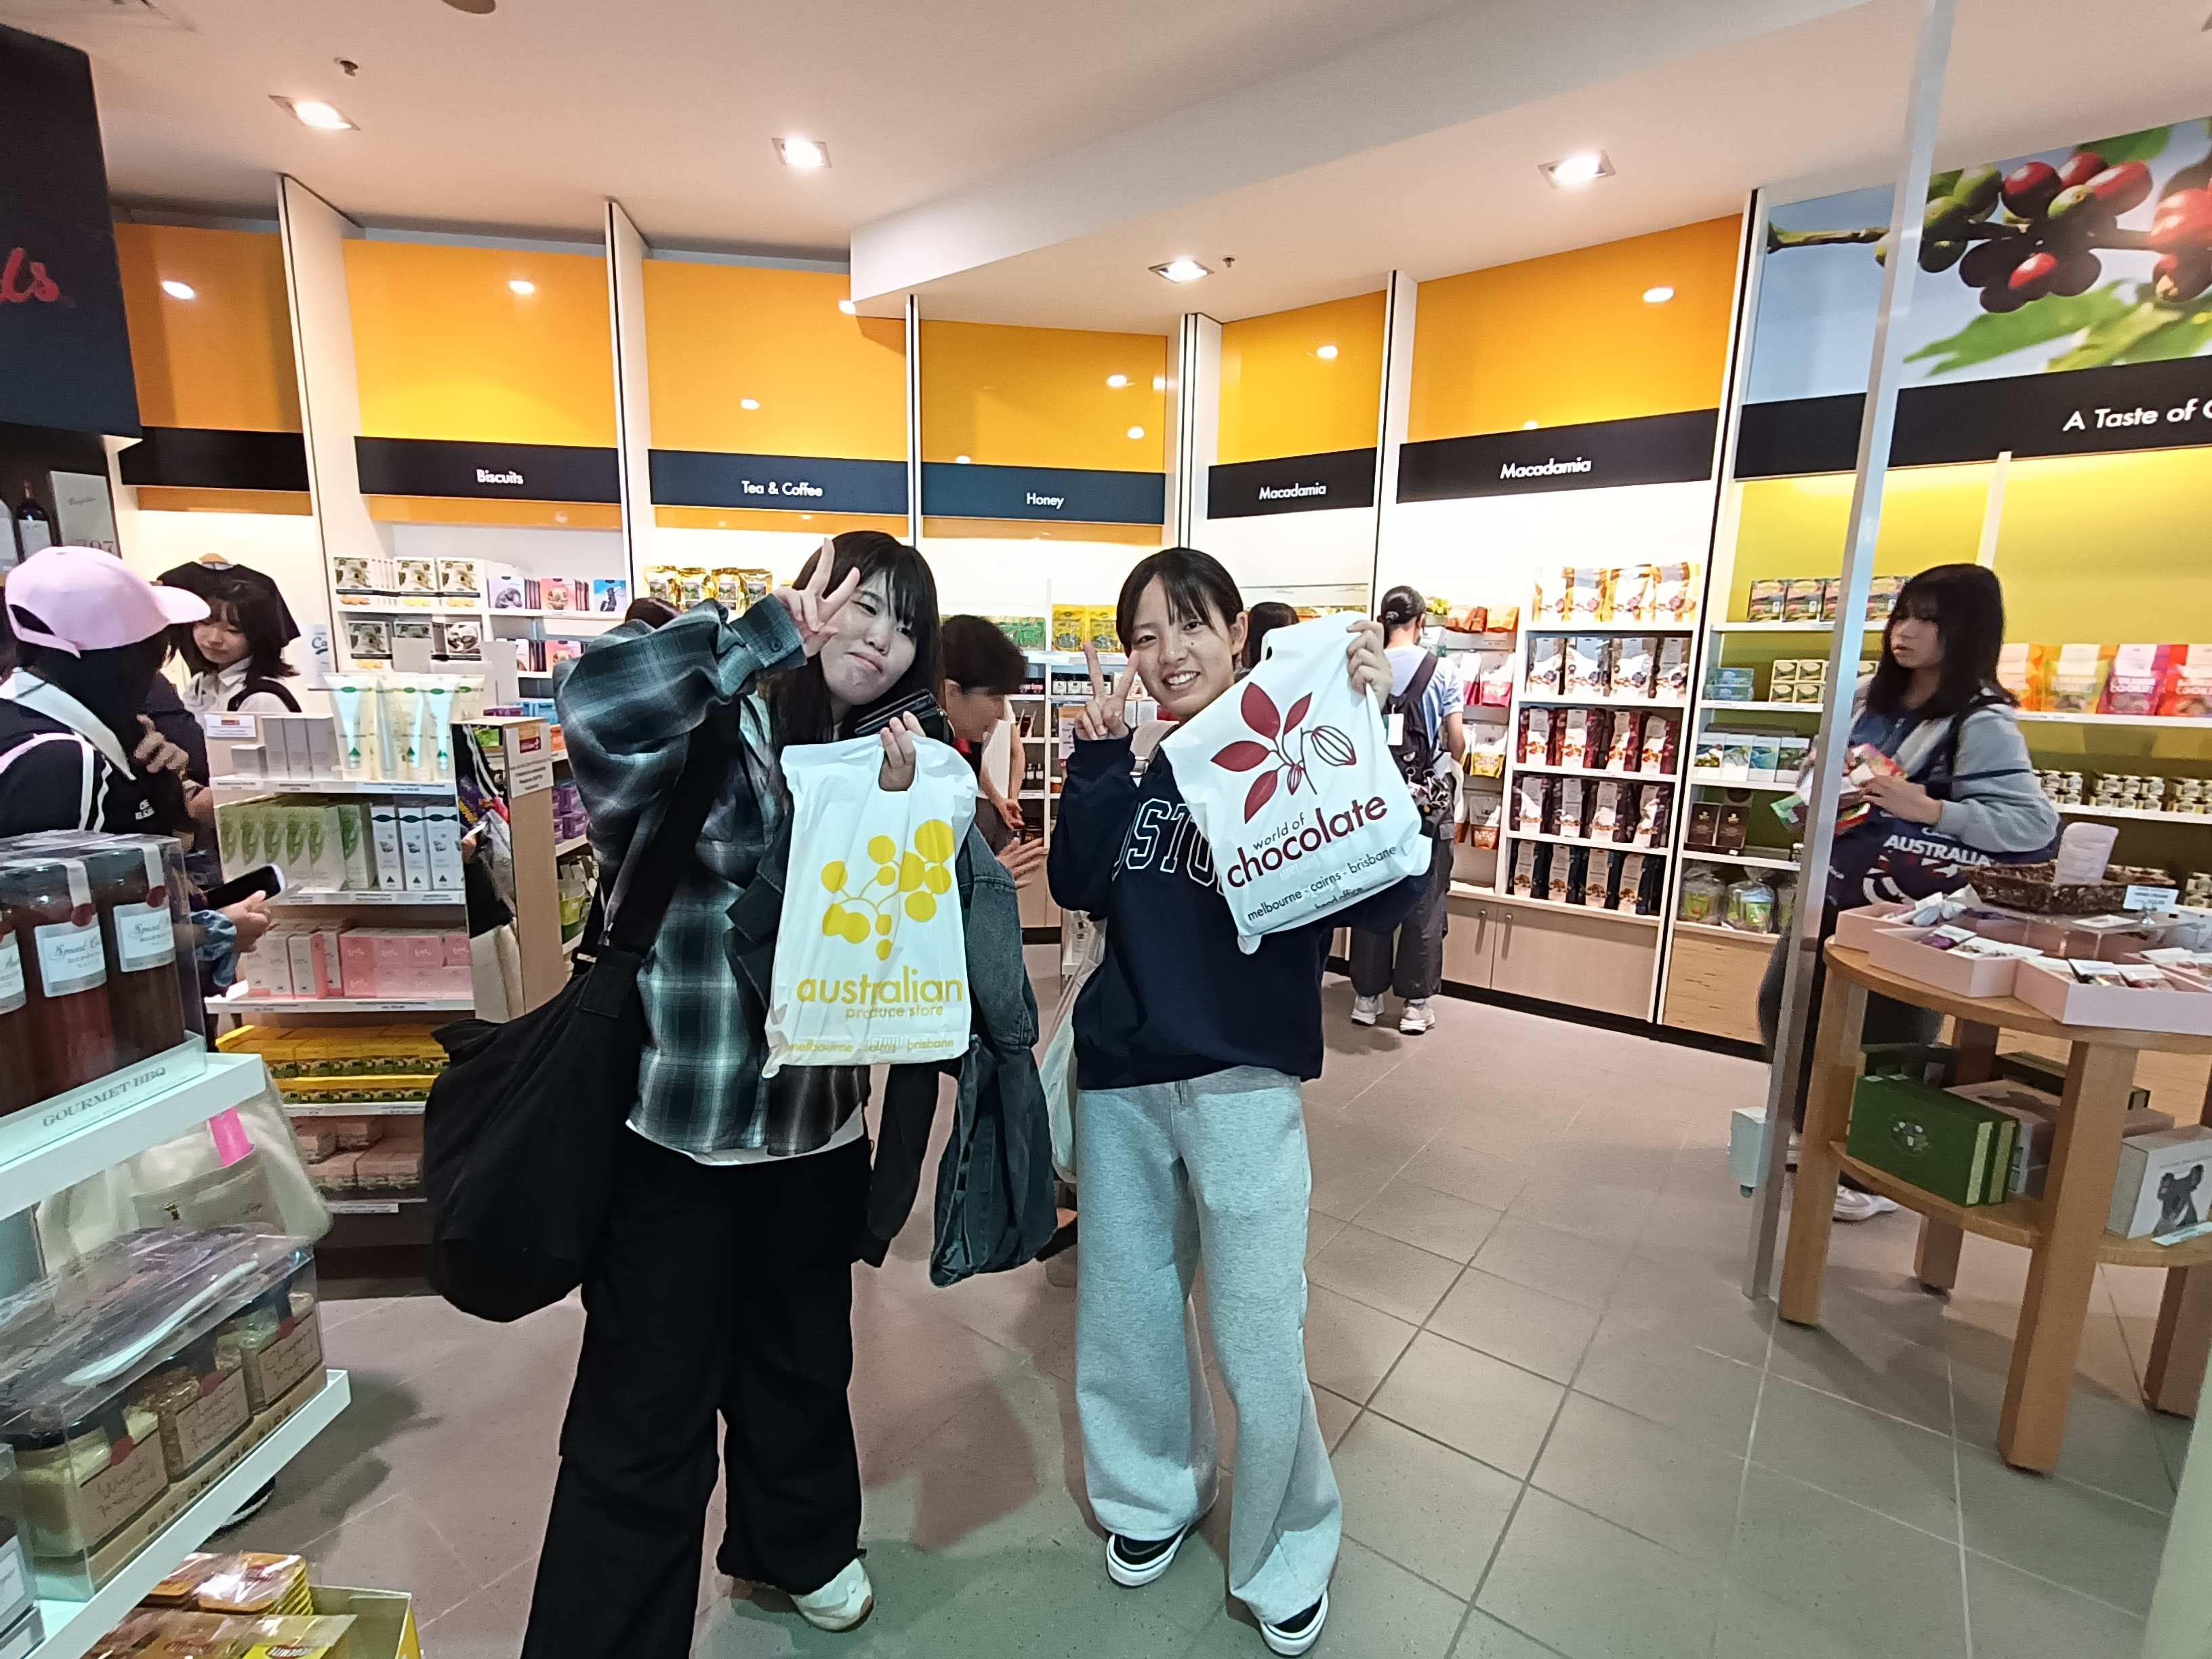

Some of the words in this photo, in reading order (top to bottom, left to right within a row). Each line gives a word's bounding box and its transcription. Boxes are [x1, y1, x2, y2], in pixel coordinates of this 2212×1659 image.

[2062, 410, 2086, 431] A
[2094, 407, 2158, 428] Taste
[2167, 398, 2200, 422] of
[476, 469, 524, 485] Biscuits
[1500, 457, 1592, 479] Macadamia
[741, 480, 764, 494] Tea
[768, 481, 779, 495] &
[781, 482, 823, 497] Coffee
[1026, 492, 1065, 510] Honey
[1258, 482, 1326, 500] Macadamia
[1227, 796, 1388, 888] chocolate
[1252, 822, 1289, 851] world
[1292, 812, 1305, 830] of
[1883, 834, 1992, 867] AUSTRALIA
[1248, 889, 1303, 922] melbourne
[1310, 871, 1342, 893] cairns
[1347, 846, 1397, 874] brisbane
[796, 964, 963, 1004] australian
[845, 1004, 904, 1021] produce
[909, 1002, 943, 1017] store
[907, 1037, 954, 1051] brisbane
[42, 1080, 131, 1127] GOURMET
[134, 1067, 167, 1088] BBQ
